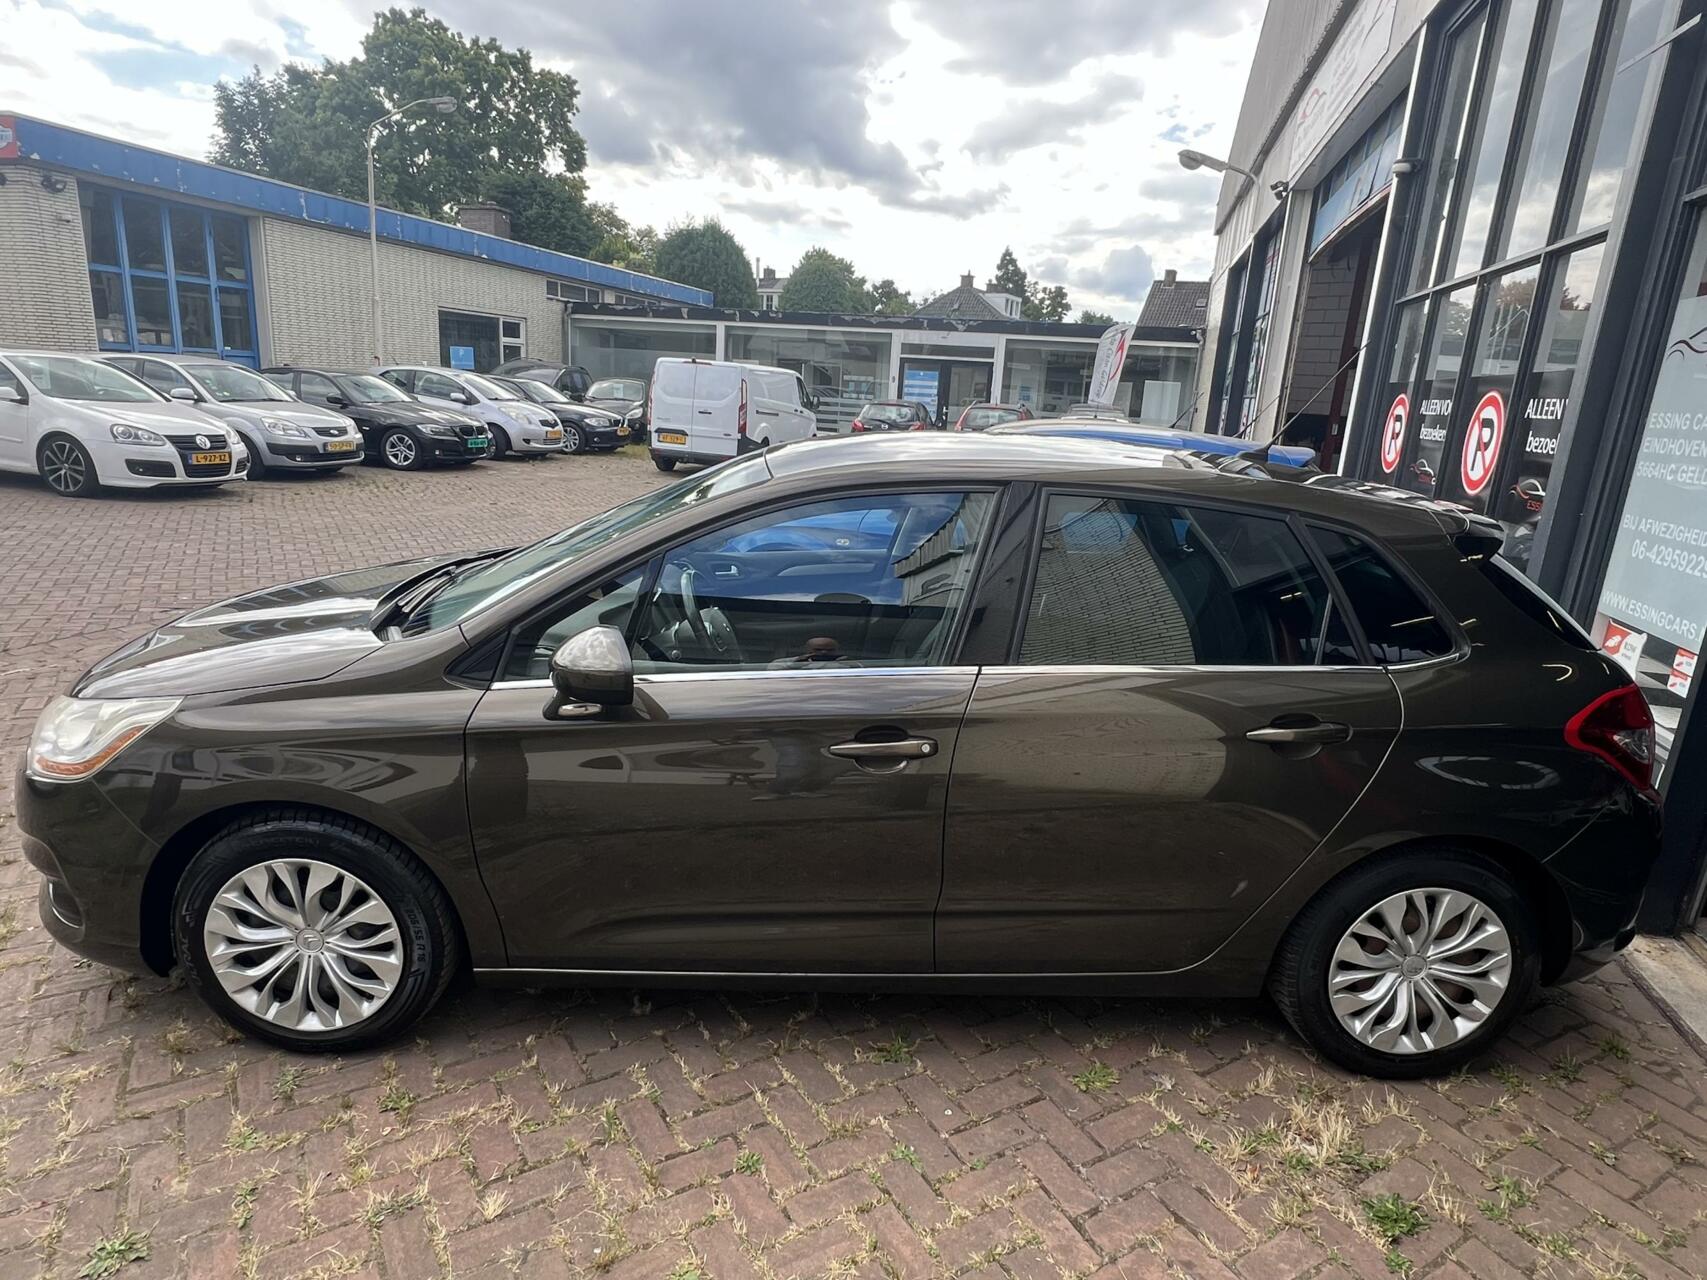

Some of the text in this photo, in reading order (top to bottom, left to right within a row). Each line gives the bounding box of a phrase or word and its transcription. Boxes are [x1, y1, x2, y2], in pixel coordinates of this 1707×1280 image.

[1525, 399, 1564, 420] ALLEEN
[1649, 412, 1691, 430] ESSING
[1636, 460, 1675, 480] 5664HC
[1623, 514, 1639, 530] BIJ
